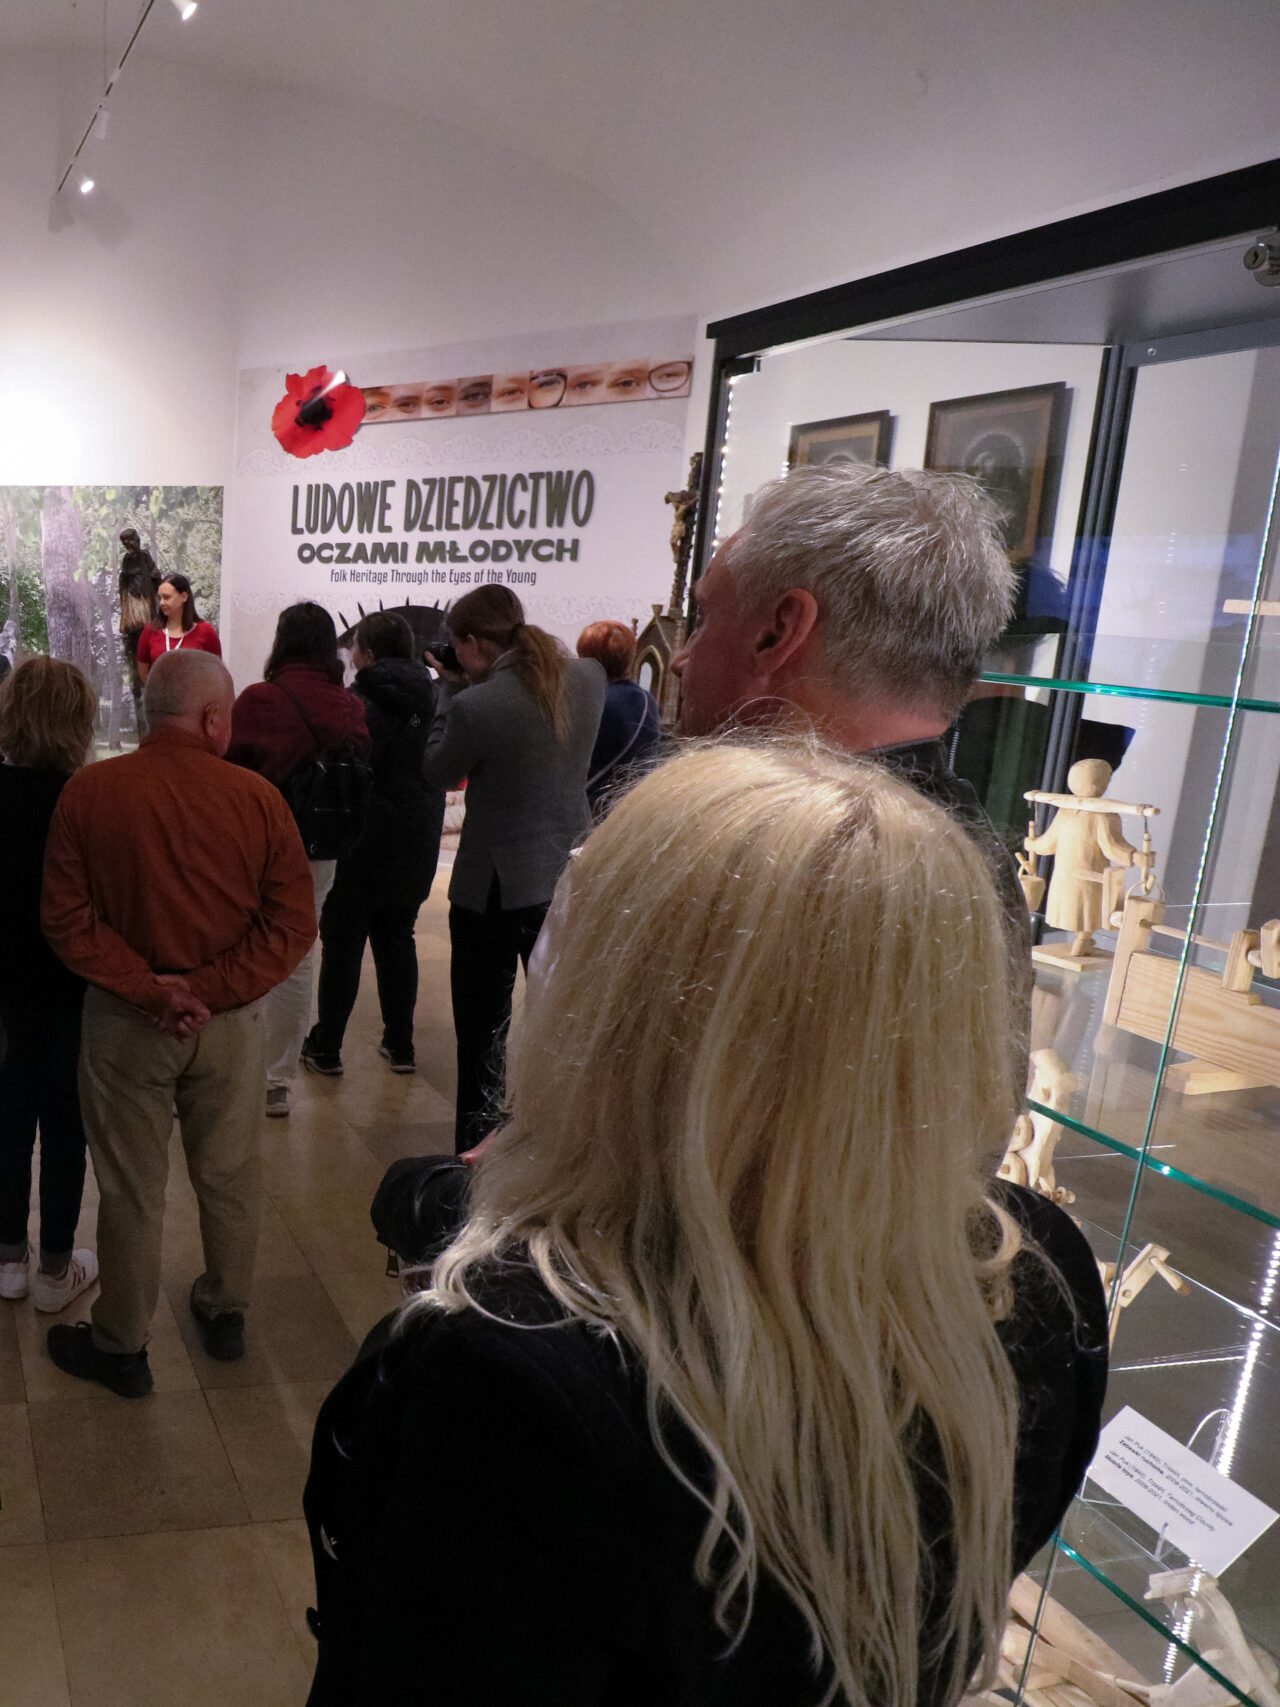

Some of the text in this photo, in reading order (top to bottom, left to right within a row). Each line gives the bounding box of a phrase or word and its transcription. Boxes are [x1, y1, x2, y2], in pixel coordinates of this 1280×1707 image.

[291, 469, 595, 535] LUDOWE DZIEDZICTWO
[297, 538, 580, 564] OCZAMI MŁODYCH
[330, 569, 537, 585] Folk Heritage Through the Eyes of the Young
